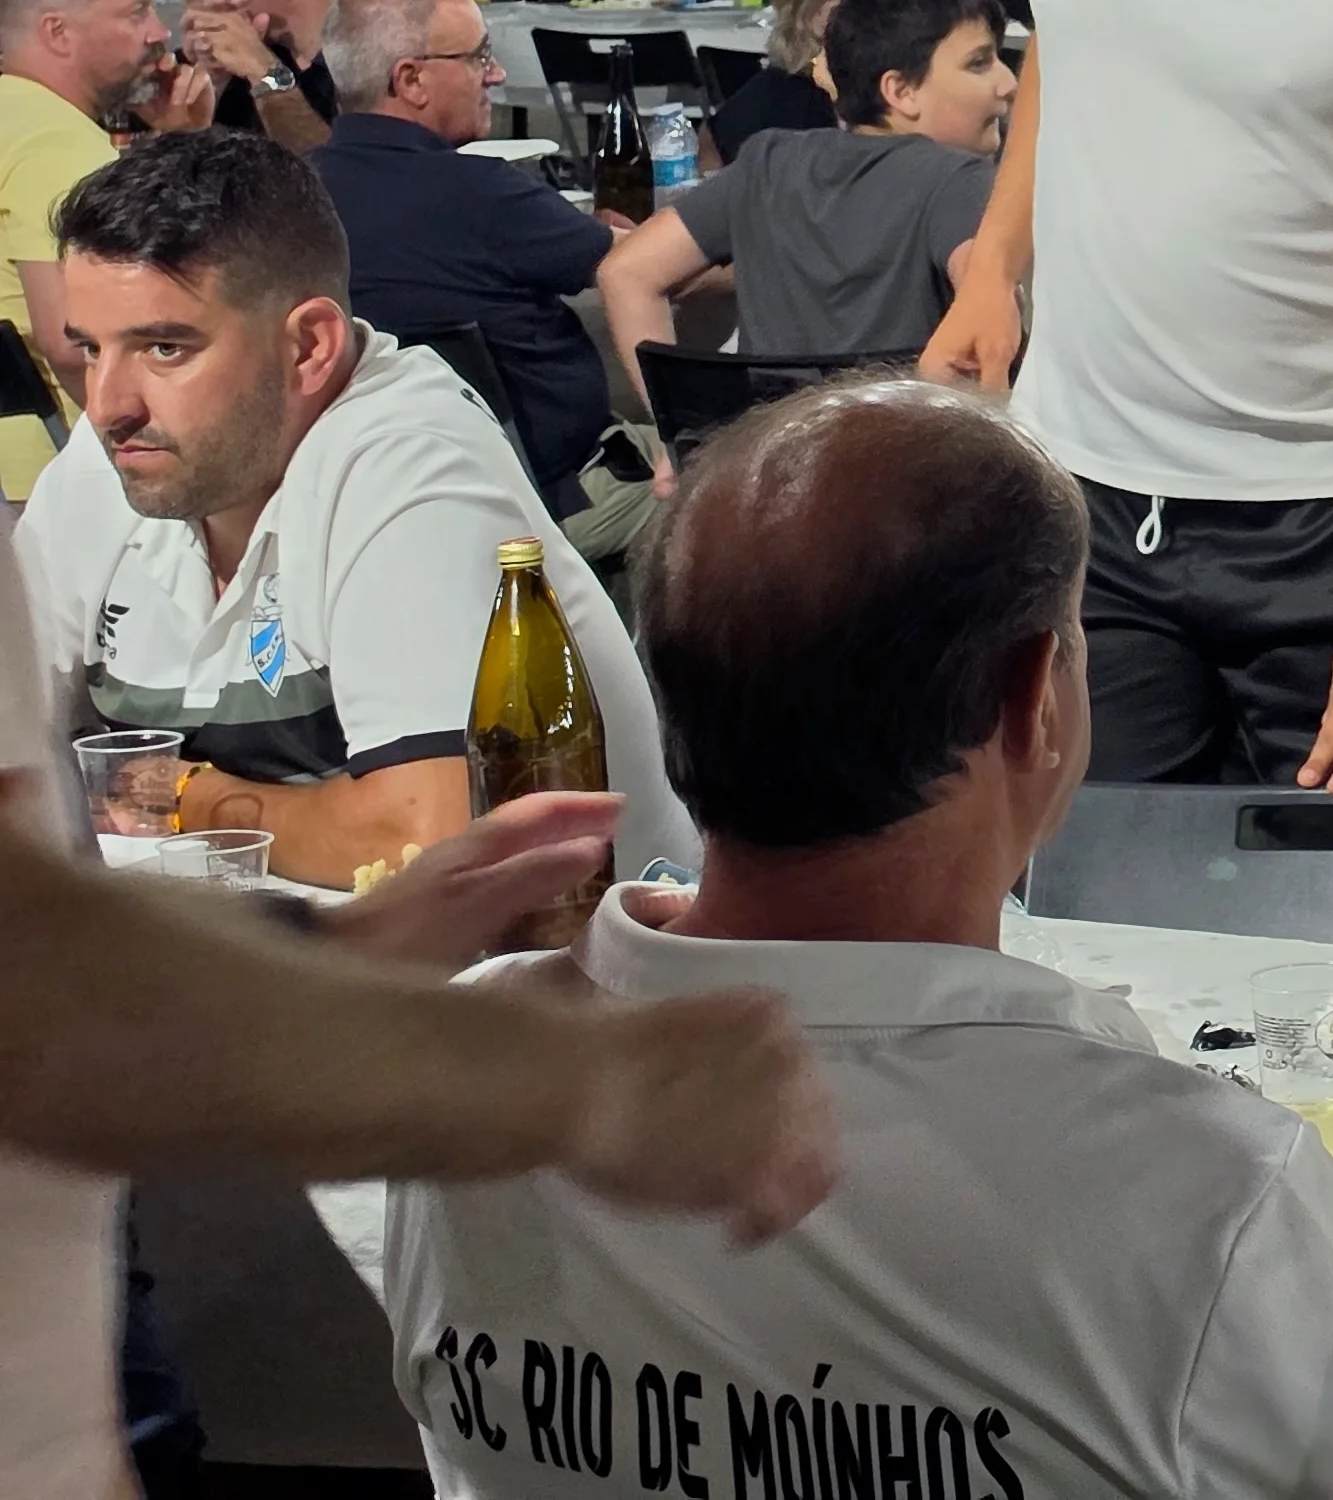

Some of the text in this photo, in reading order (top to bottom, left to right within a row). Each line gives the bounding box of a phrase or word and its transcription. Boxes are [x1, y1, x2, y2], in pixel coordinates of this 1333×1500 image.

[435, 1325, 507, 1451] SC
[522, 1338, 613, 1479] RIO
[635, 1362, 709, 1499] DE
